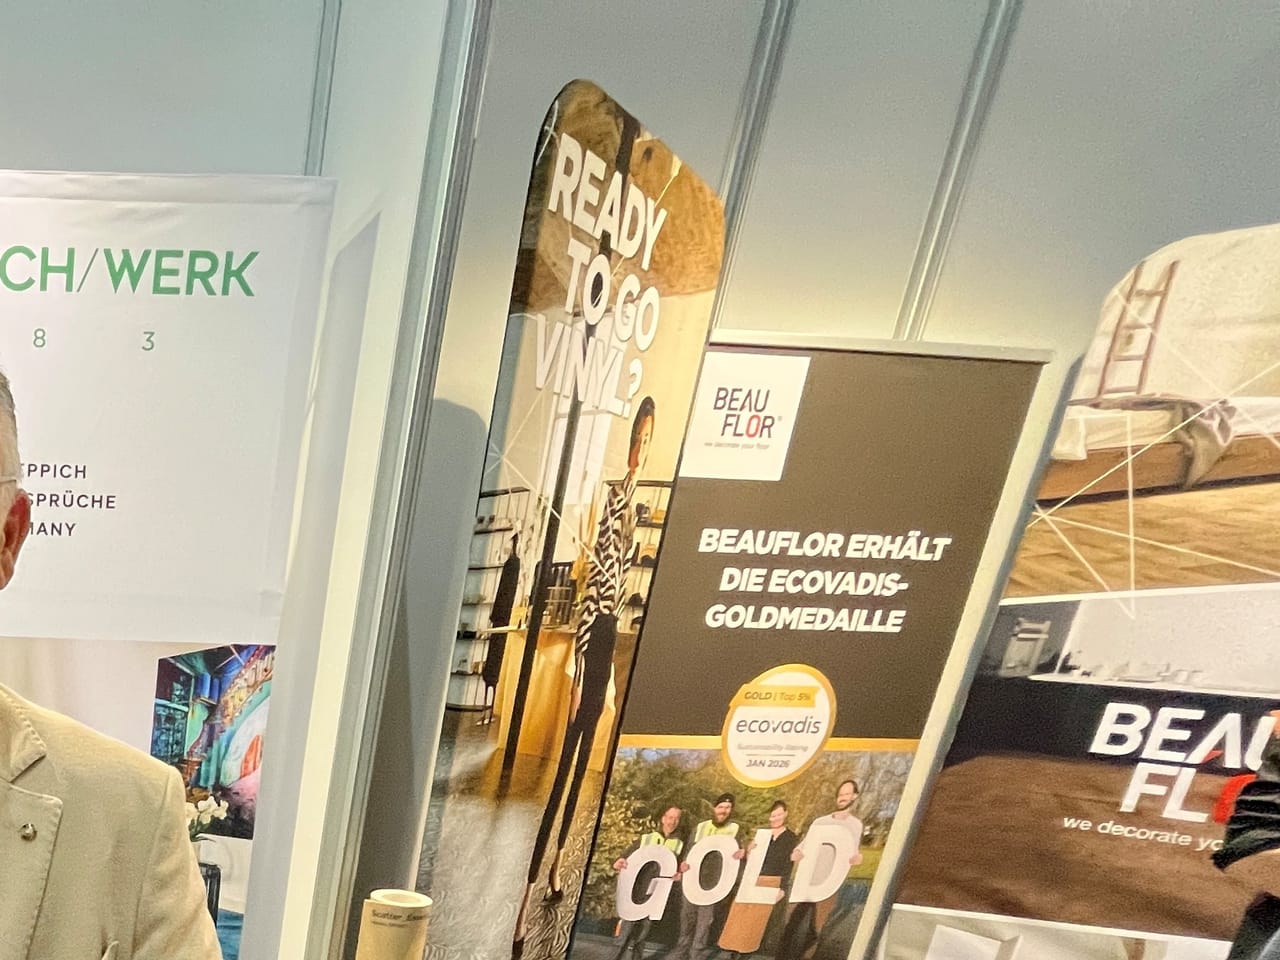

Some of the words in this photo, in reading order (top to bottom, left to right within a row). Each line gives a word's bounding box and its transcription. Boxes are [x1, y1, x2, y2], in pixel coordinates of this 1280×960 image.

[548, 132, 668, 271] READY
[565, 237, 612, 326] TO
[614, 273, 661, 352] GO
[32, 328, 48, 349] 8
[141, 331, 156, 352] 3
[535, 313, 643, 419] VINYL?
[713, 387, 771, 413] BEAU
[720, 413, 776, 439] FLOR
[698, 528, 845, 557] BEAUFLOR
[845, 530, 953, 561] ERHÄLT
[719, 567, 767, 592] DIE
[768, 569, 909, 597] ECOVADIS-
[705, 604, 907, 633] GOLDMEDAILLE
[736, 716, 822, 734] ecovadis
[1063, 816, 1092, 831] we
[1097, 820, 1192, 845] decorate
[616, 828, 853, 922] GOLD
